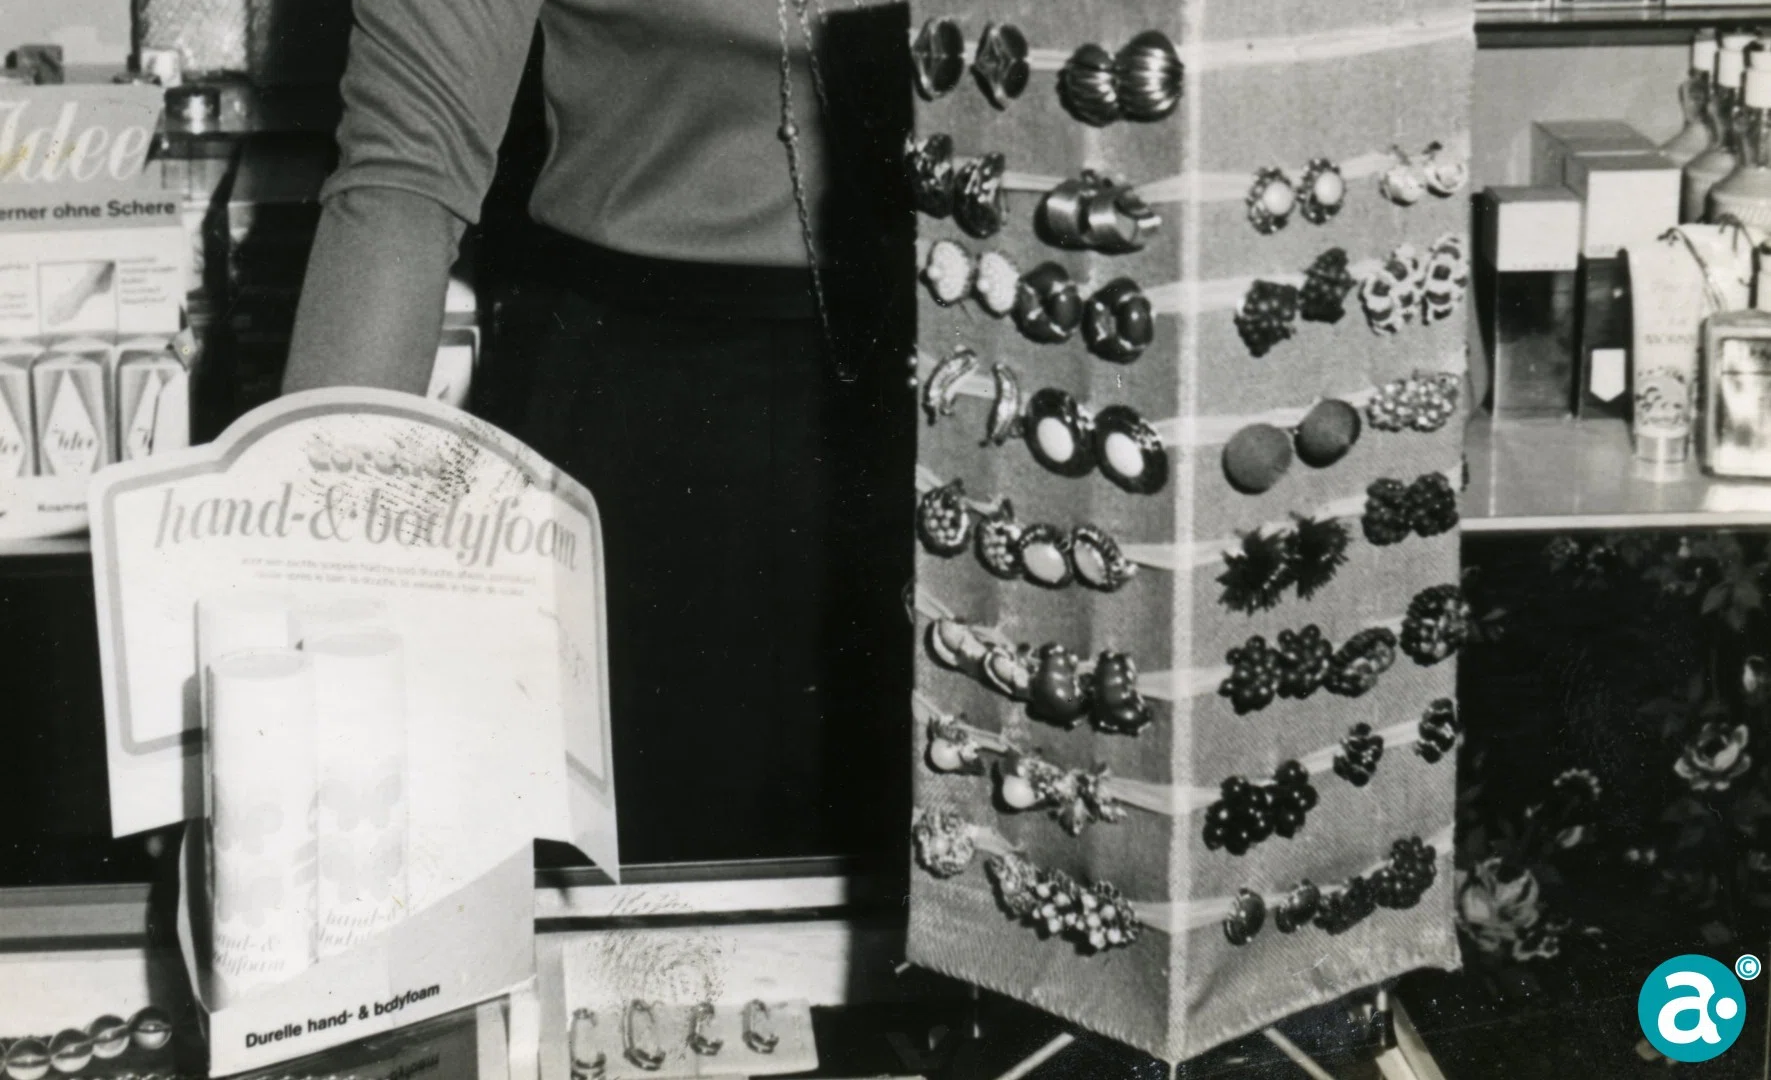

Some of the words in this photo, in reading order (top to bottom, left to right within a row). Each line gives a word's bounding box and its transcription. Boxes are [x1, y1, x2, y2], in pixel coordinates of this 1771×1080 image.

[52, 201, 100, 218] ohne
[107, 199, 175, 217] Schere
[364, 485, 579, 572] bodyfoam
[245, 1023, 302, 1048] Durelle
[307, 1012, 354, 1034] hand-
[358, 1004, 370, 1021] &
[374, 983, 441, 1016] bodyfoam
